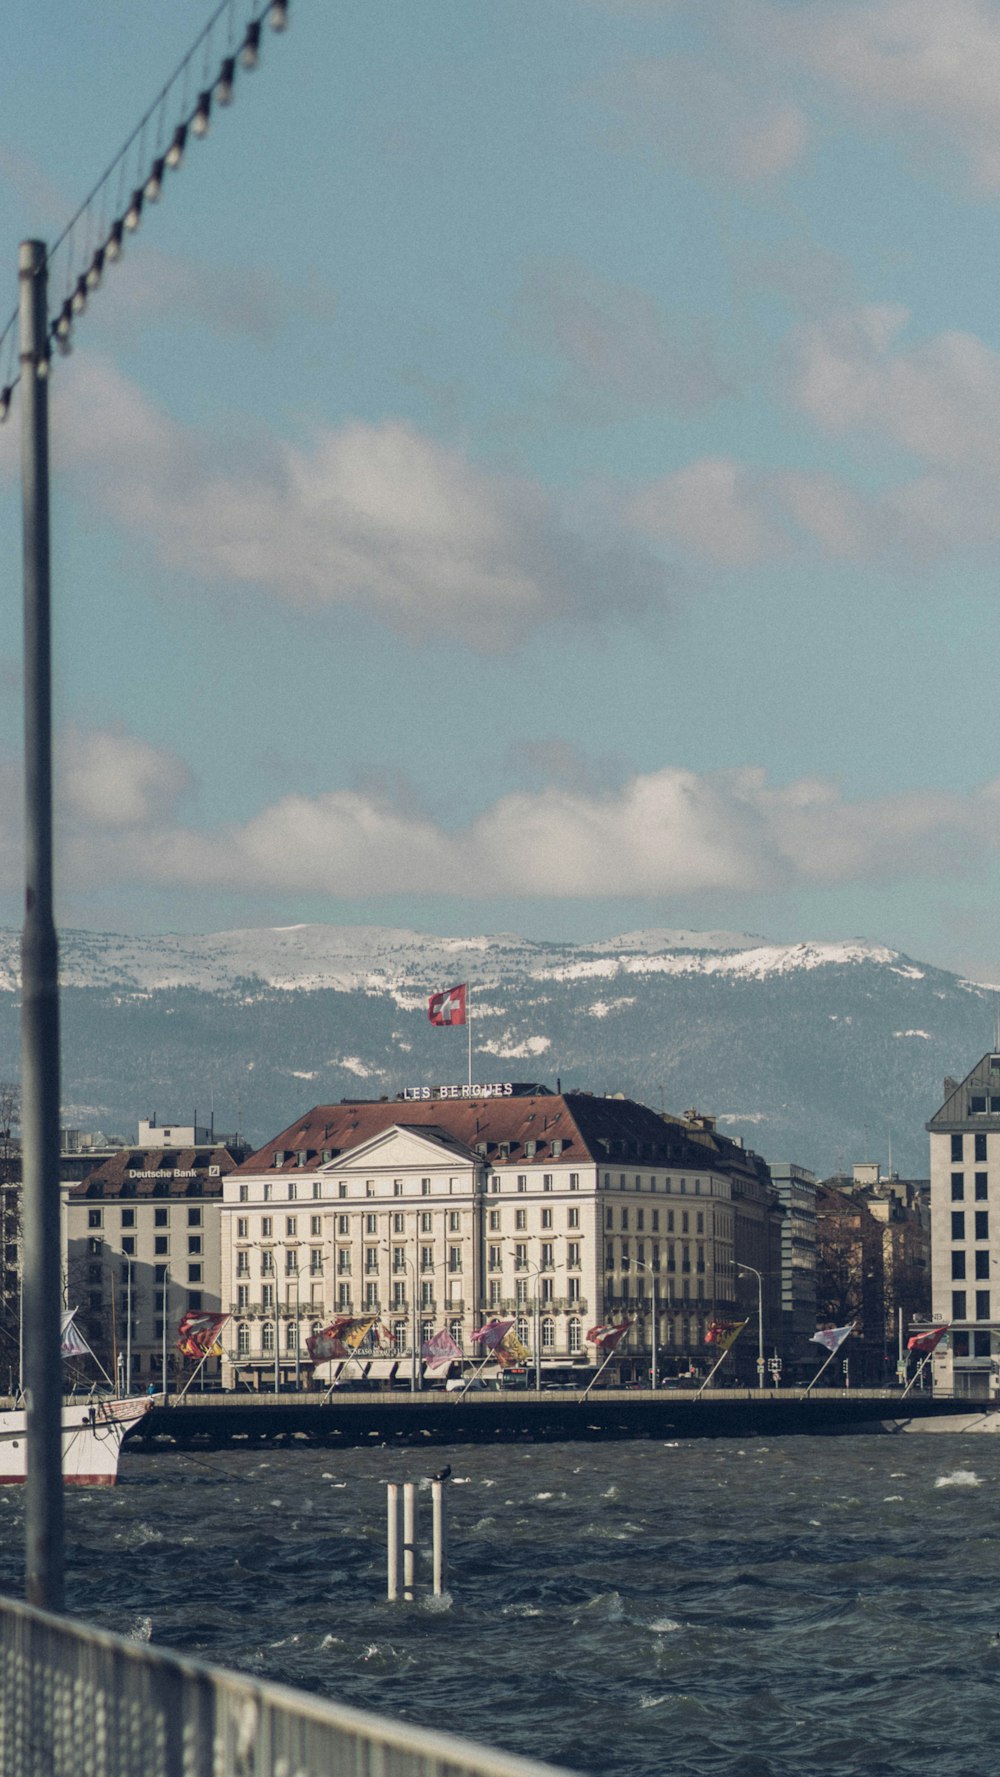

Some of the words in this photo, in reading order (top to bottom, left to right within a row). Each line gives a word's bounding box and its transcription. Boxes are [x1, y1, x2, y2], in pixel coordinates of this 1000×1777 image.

[403, 1086, 431, 1100] LES
[440, 1082, 513, 1098] BERGUES
[129, 1169, 172, 1178] Deutsche
[173, 1168, 197, 1178] Bank
